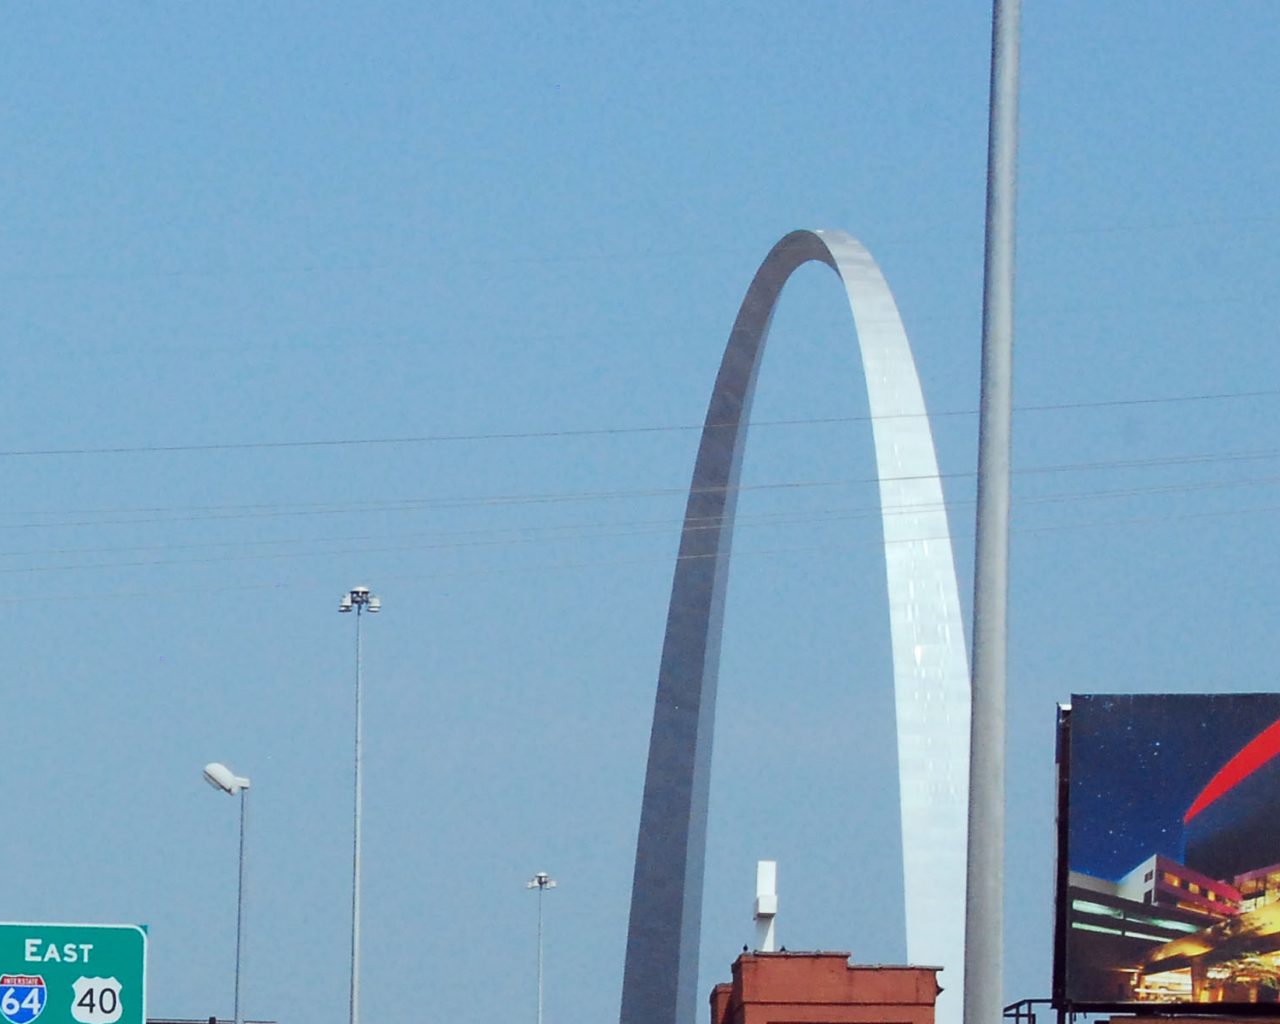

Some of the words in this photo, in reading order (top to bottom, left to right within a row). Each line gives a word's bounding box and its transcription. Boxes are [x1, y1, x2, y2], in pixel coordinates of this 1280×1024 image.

[25, 938, 94, 963] EAST
[2, 976, 39, 986] INTERSTATE
[1, 988, 41, 1015] 64
[77, 987, 117, 1014] 40
